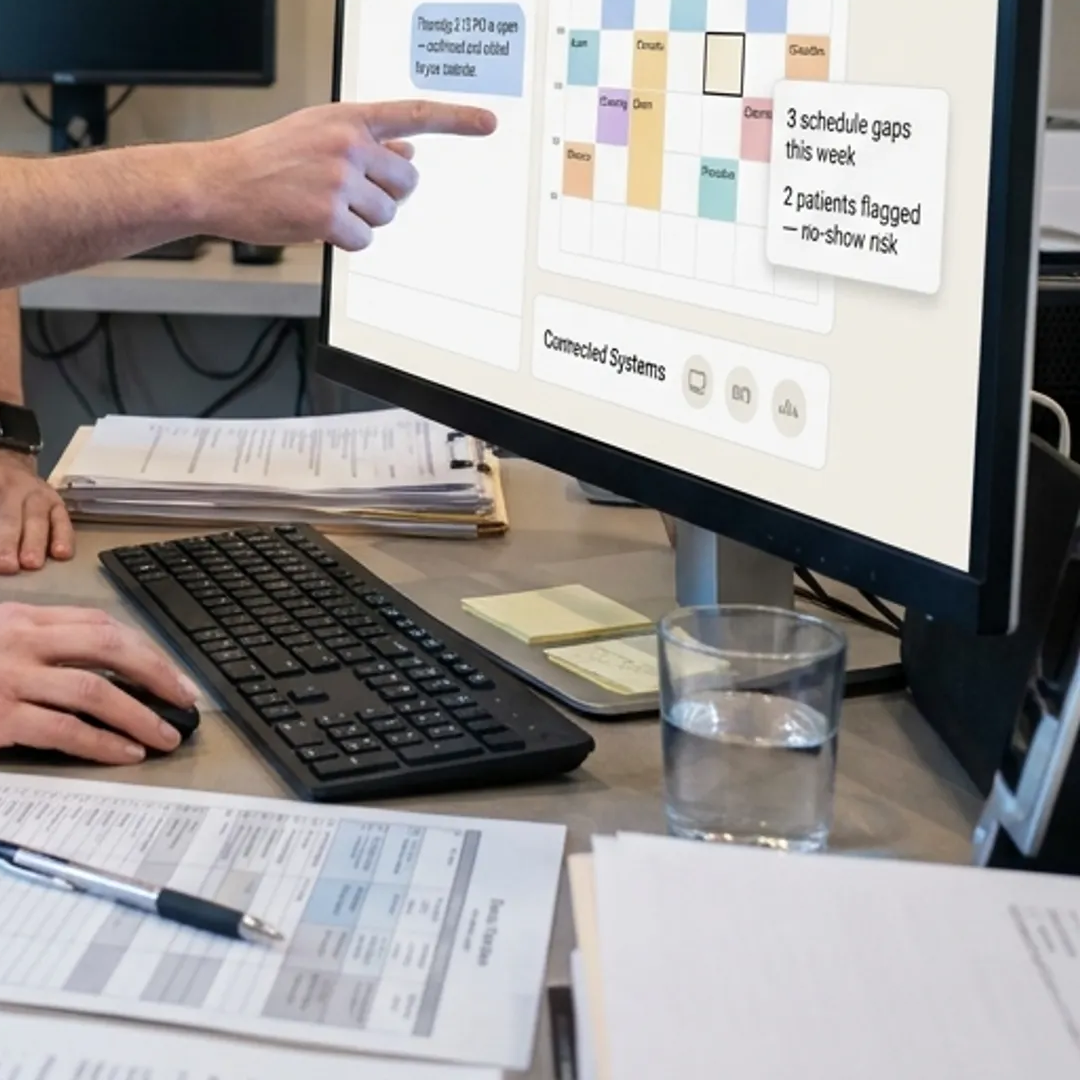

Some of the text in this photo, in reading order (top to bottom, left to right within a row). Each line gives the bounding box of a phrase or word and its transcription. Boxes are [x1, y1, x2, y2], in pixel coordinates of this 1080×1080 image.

[786, 107, 797, 129] 3
[800, 110, 869, 135] schedule
[871, 119, 912, 143] gaps
[785, 138, 856, 167] this week
[783, 185, 922, 228] 2 patients flagged
[869, 232, 898, 255] risk
[609, 347, 667, 382] Systems
